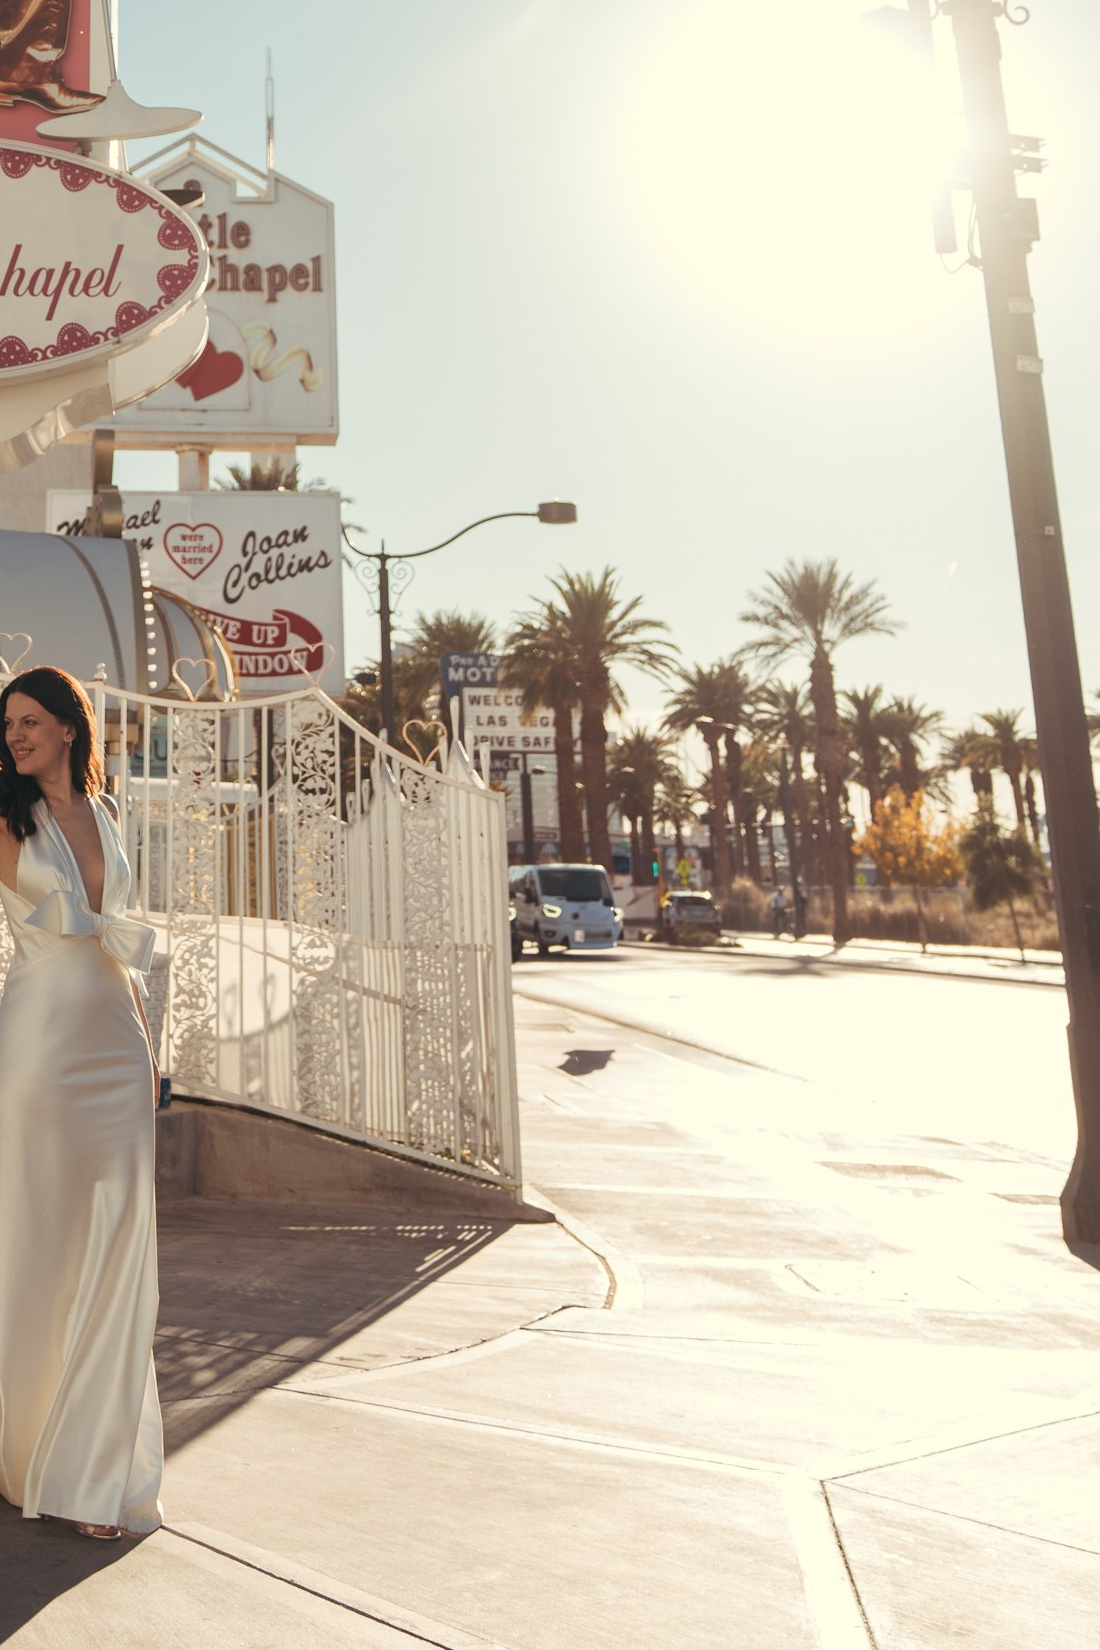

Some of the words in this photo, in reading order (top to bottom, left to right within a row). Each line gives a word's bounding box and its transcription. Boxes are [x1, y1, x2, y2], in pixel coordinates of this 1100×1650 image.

[197, 212, 251, 249] tle
[205, 254, 324, 304] hapel
[180, 533, 204, 542] were
[171, 544, 214, 554] married
[241, 524, 309, 574] Joan
[181, 555, 204, 565] here
[222, 549, 333, 604] Collins
[251, 623, 280, 645] UP
[234, 651, 309, 675] INDOW
[448, 667, 495, 682] MOT
[468, 694, 524, 706] WELCO
[476, 715, 508, 727] LAS
[517, 715, 556, 728] VEG
